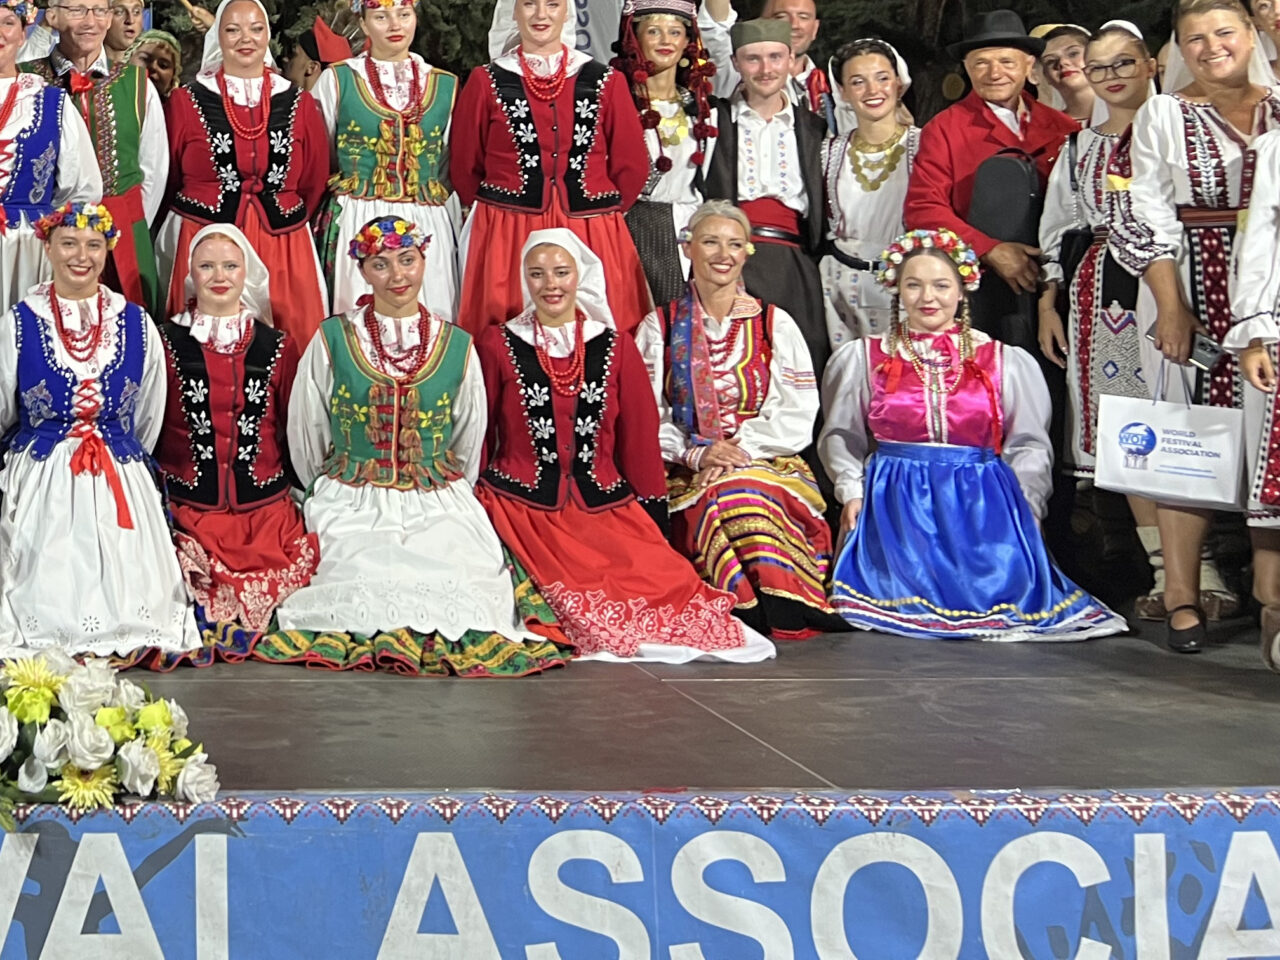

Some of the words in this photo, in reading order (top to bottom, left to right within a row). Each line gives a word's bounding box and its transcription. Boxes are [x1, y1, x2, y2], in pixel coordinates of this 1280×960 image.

[1162, 429, 1196, 438] WORLD
[1161, 437, 1202, 447] FESTIVAL
[1160, 447, 1221, 458] ASSOCIATION
